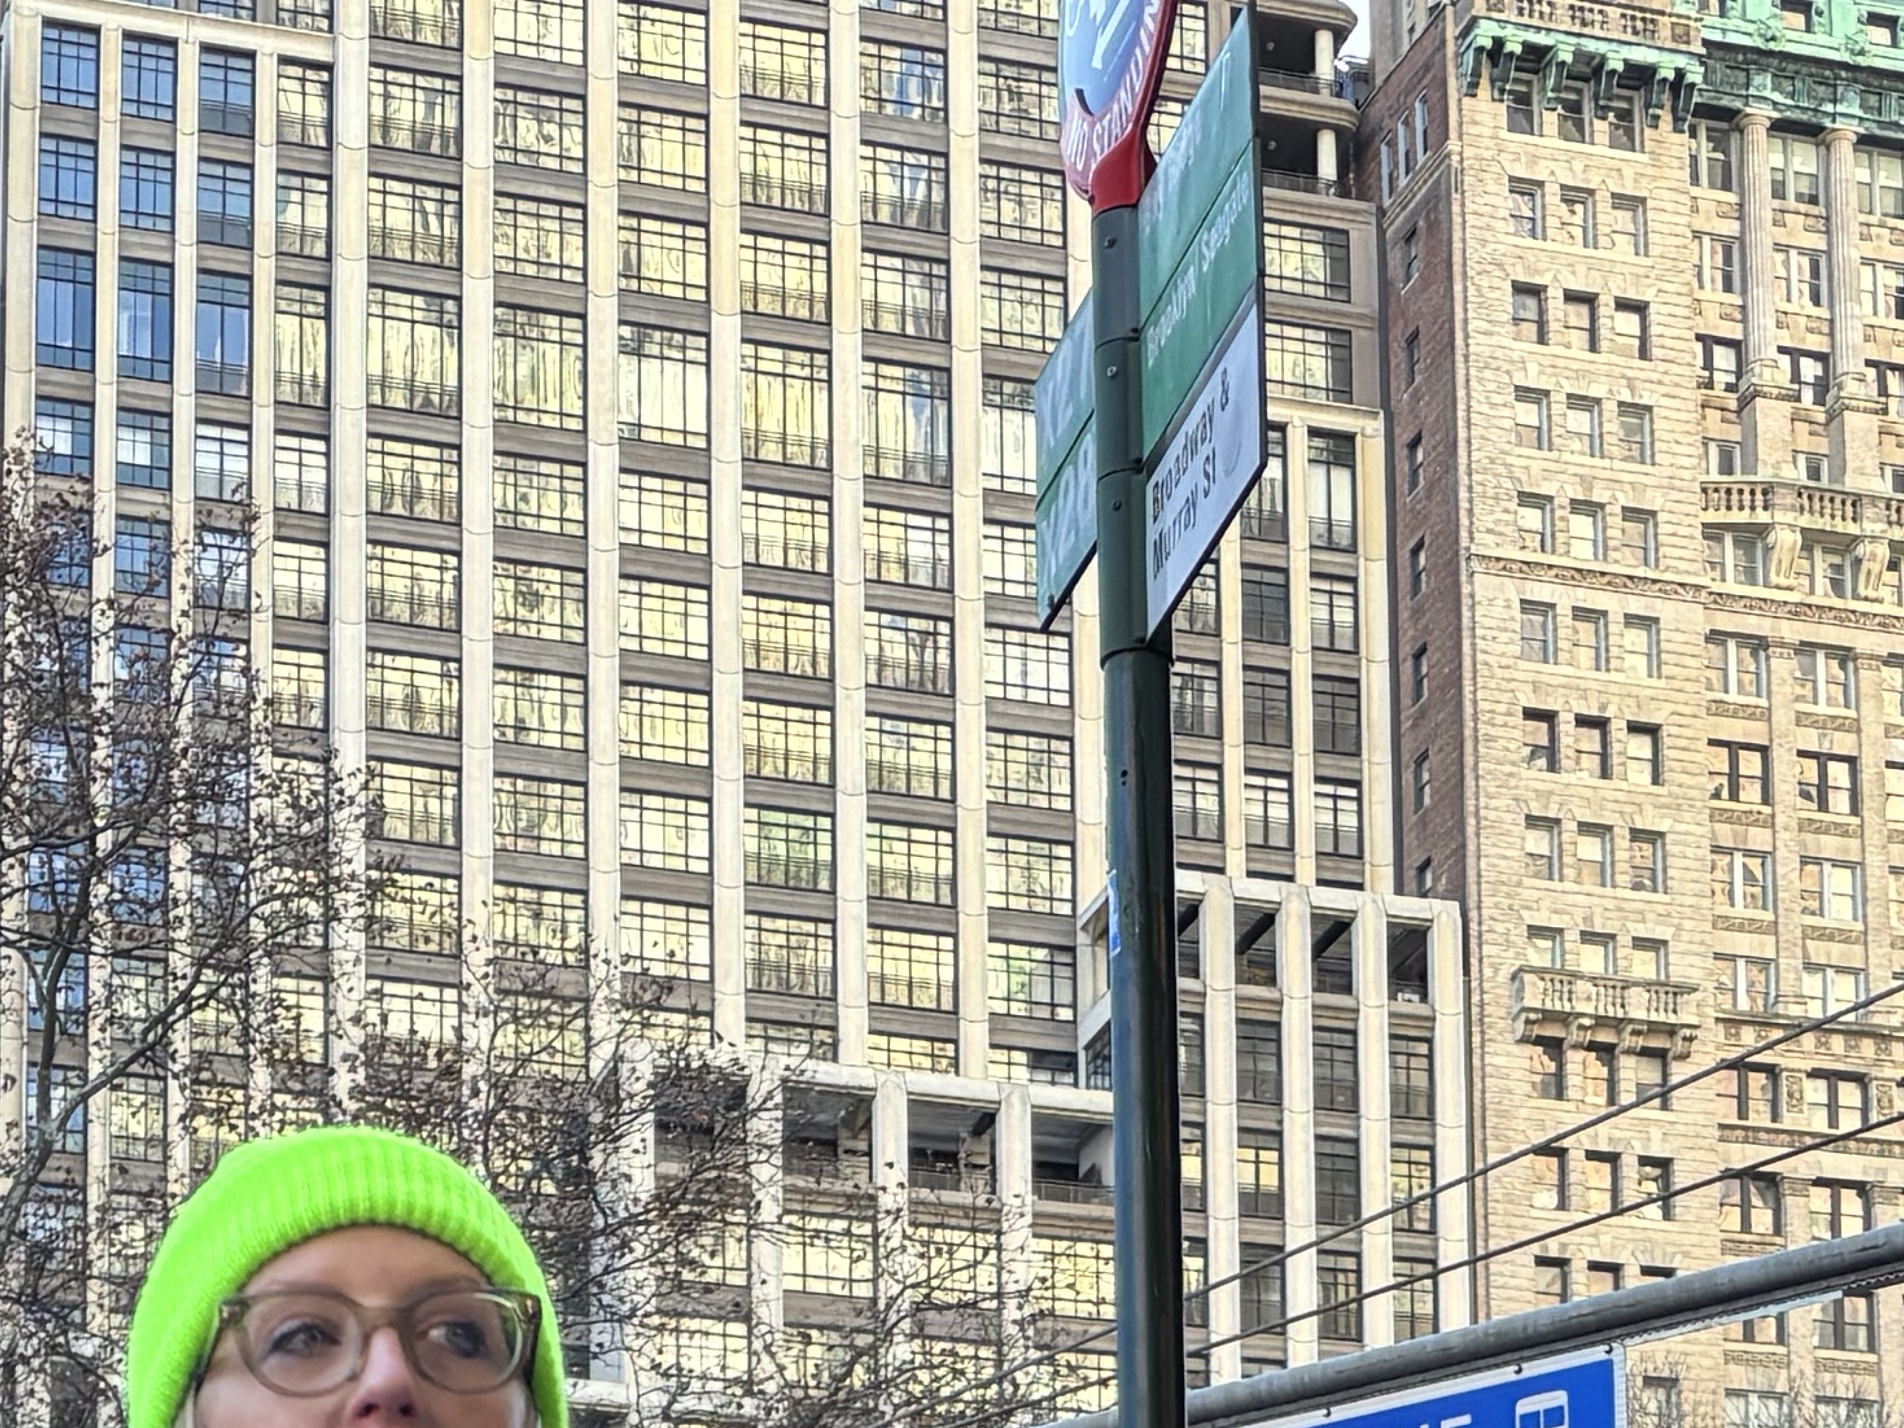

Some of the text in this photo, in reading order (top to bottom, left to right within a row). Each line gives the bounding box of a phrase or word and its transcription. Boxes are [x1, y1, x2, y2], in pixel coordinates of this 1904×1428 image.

[1067, 109, 1088, 171] NO
[1147, 264, 1196, 368] Brooklyn
[1153, 367, 1230, 524] Broadway &
[1153, 446, 1217, 580] Murray St
